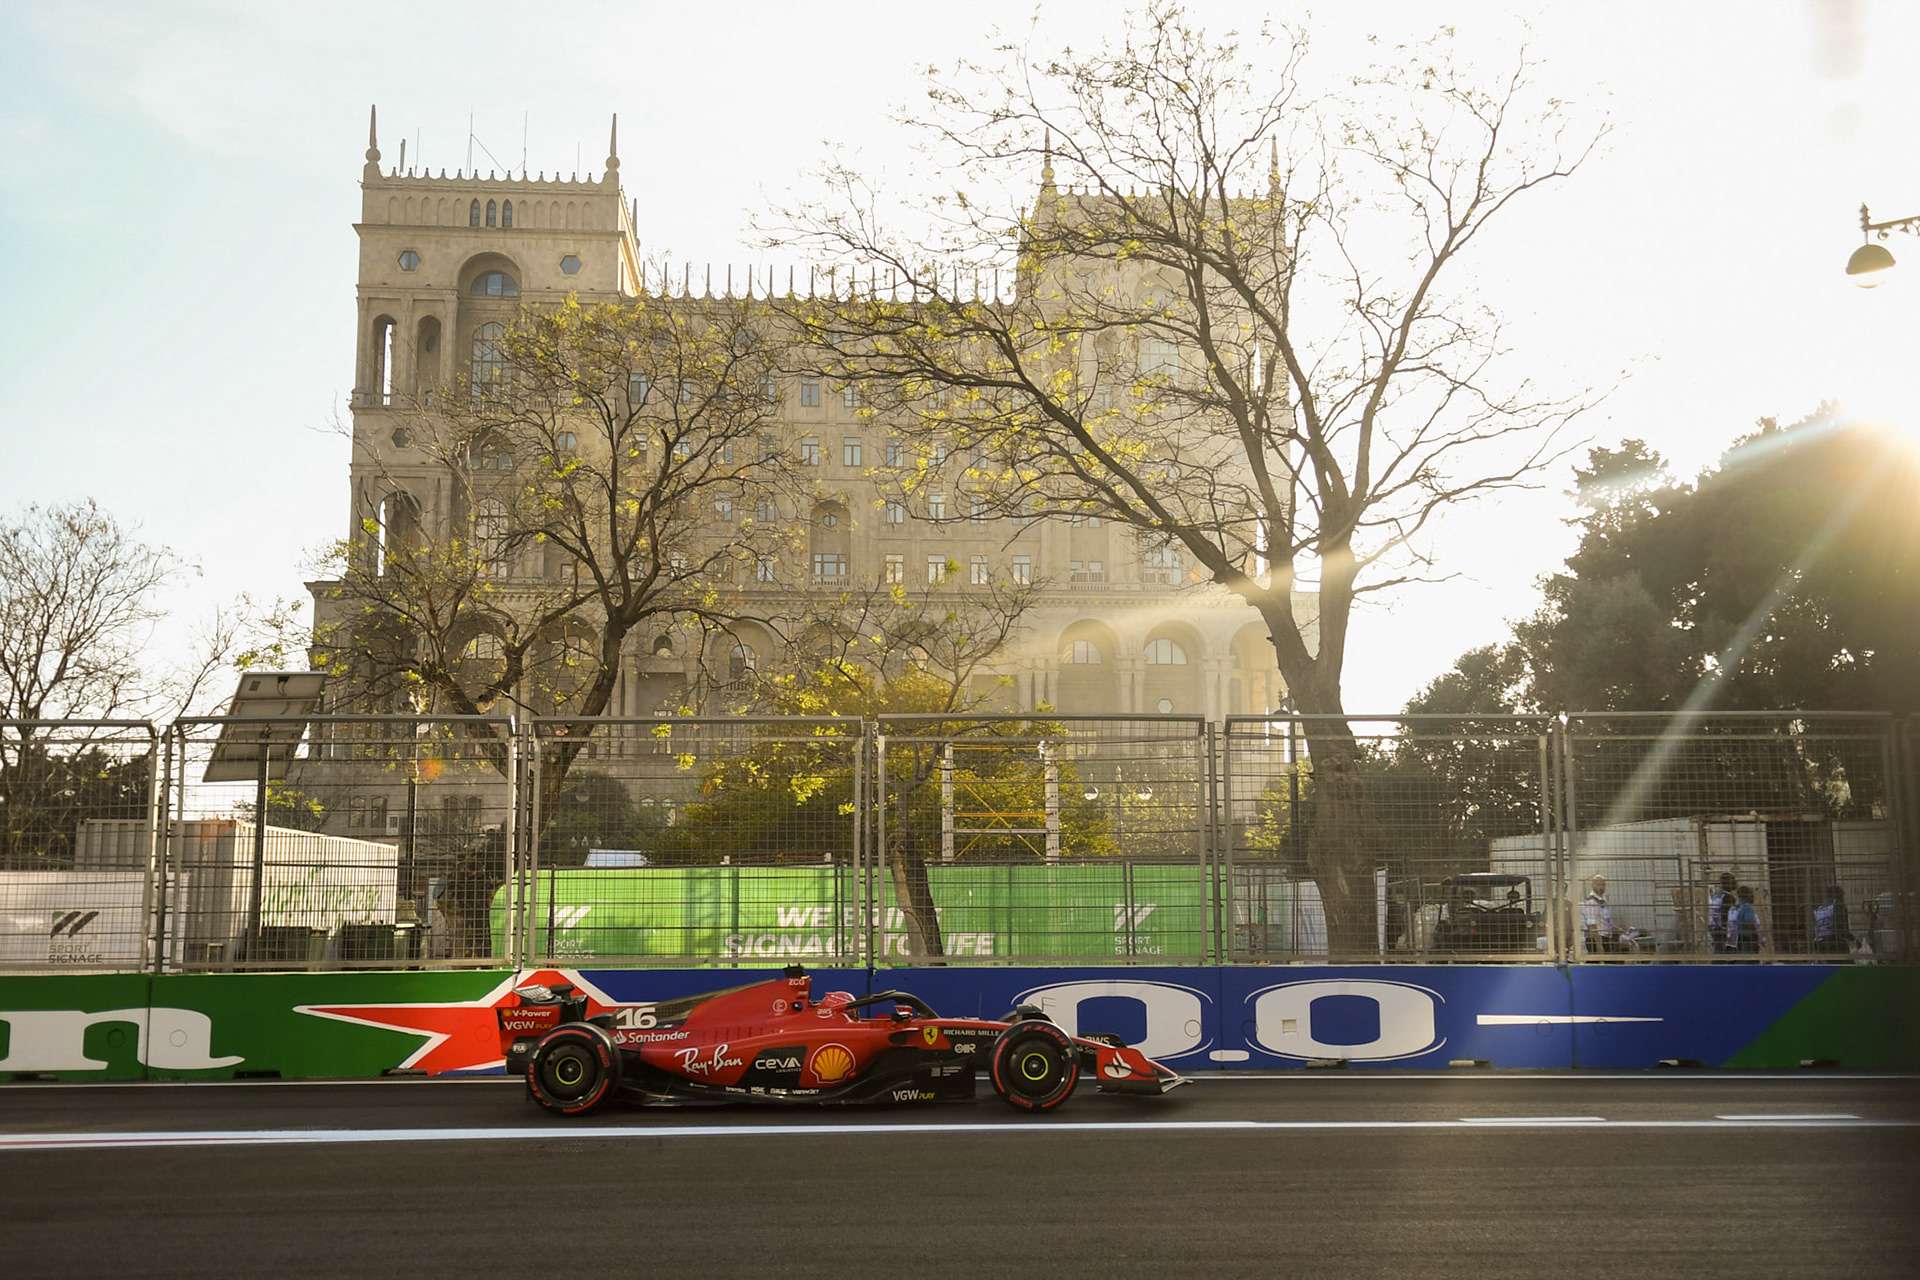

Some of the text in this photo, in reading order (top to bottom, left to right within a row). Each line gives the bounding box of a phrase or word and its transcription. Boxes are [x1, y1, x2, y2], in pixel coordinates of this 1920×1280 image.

[777, 907, 831, 928] WE
[49, 944, 90, 953] SPORT
[49, 954, 102, 964] SIGNAGE
[512, 1009, 551, 1017] V-Power
[616, 1007, 657, 1029] 16
[504, 1021, 535, 1030] VGW
[628, 1031, 690, 1044] Santander
[512, 1044, 527, 1052] FIA
[892, 1089, 919, 1102] VGW
